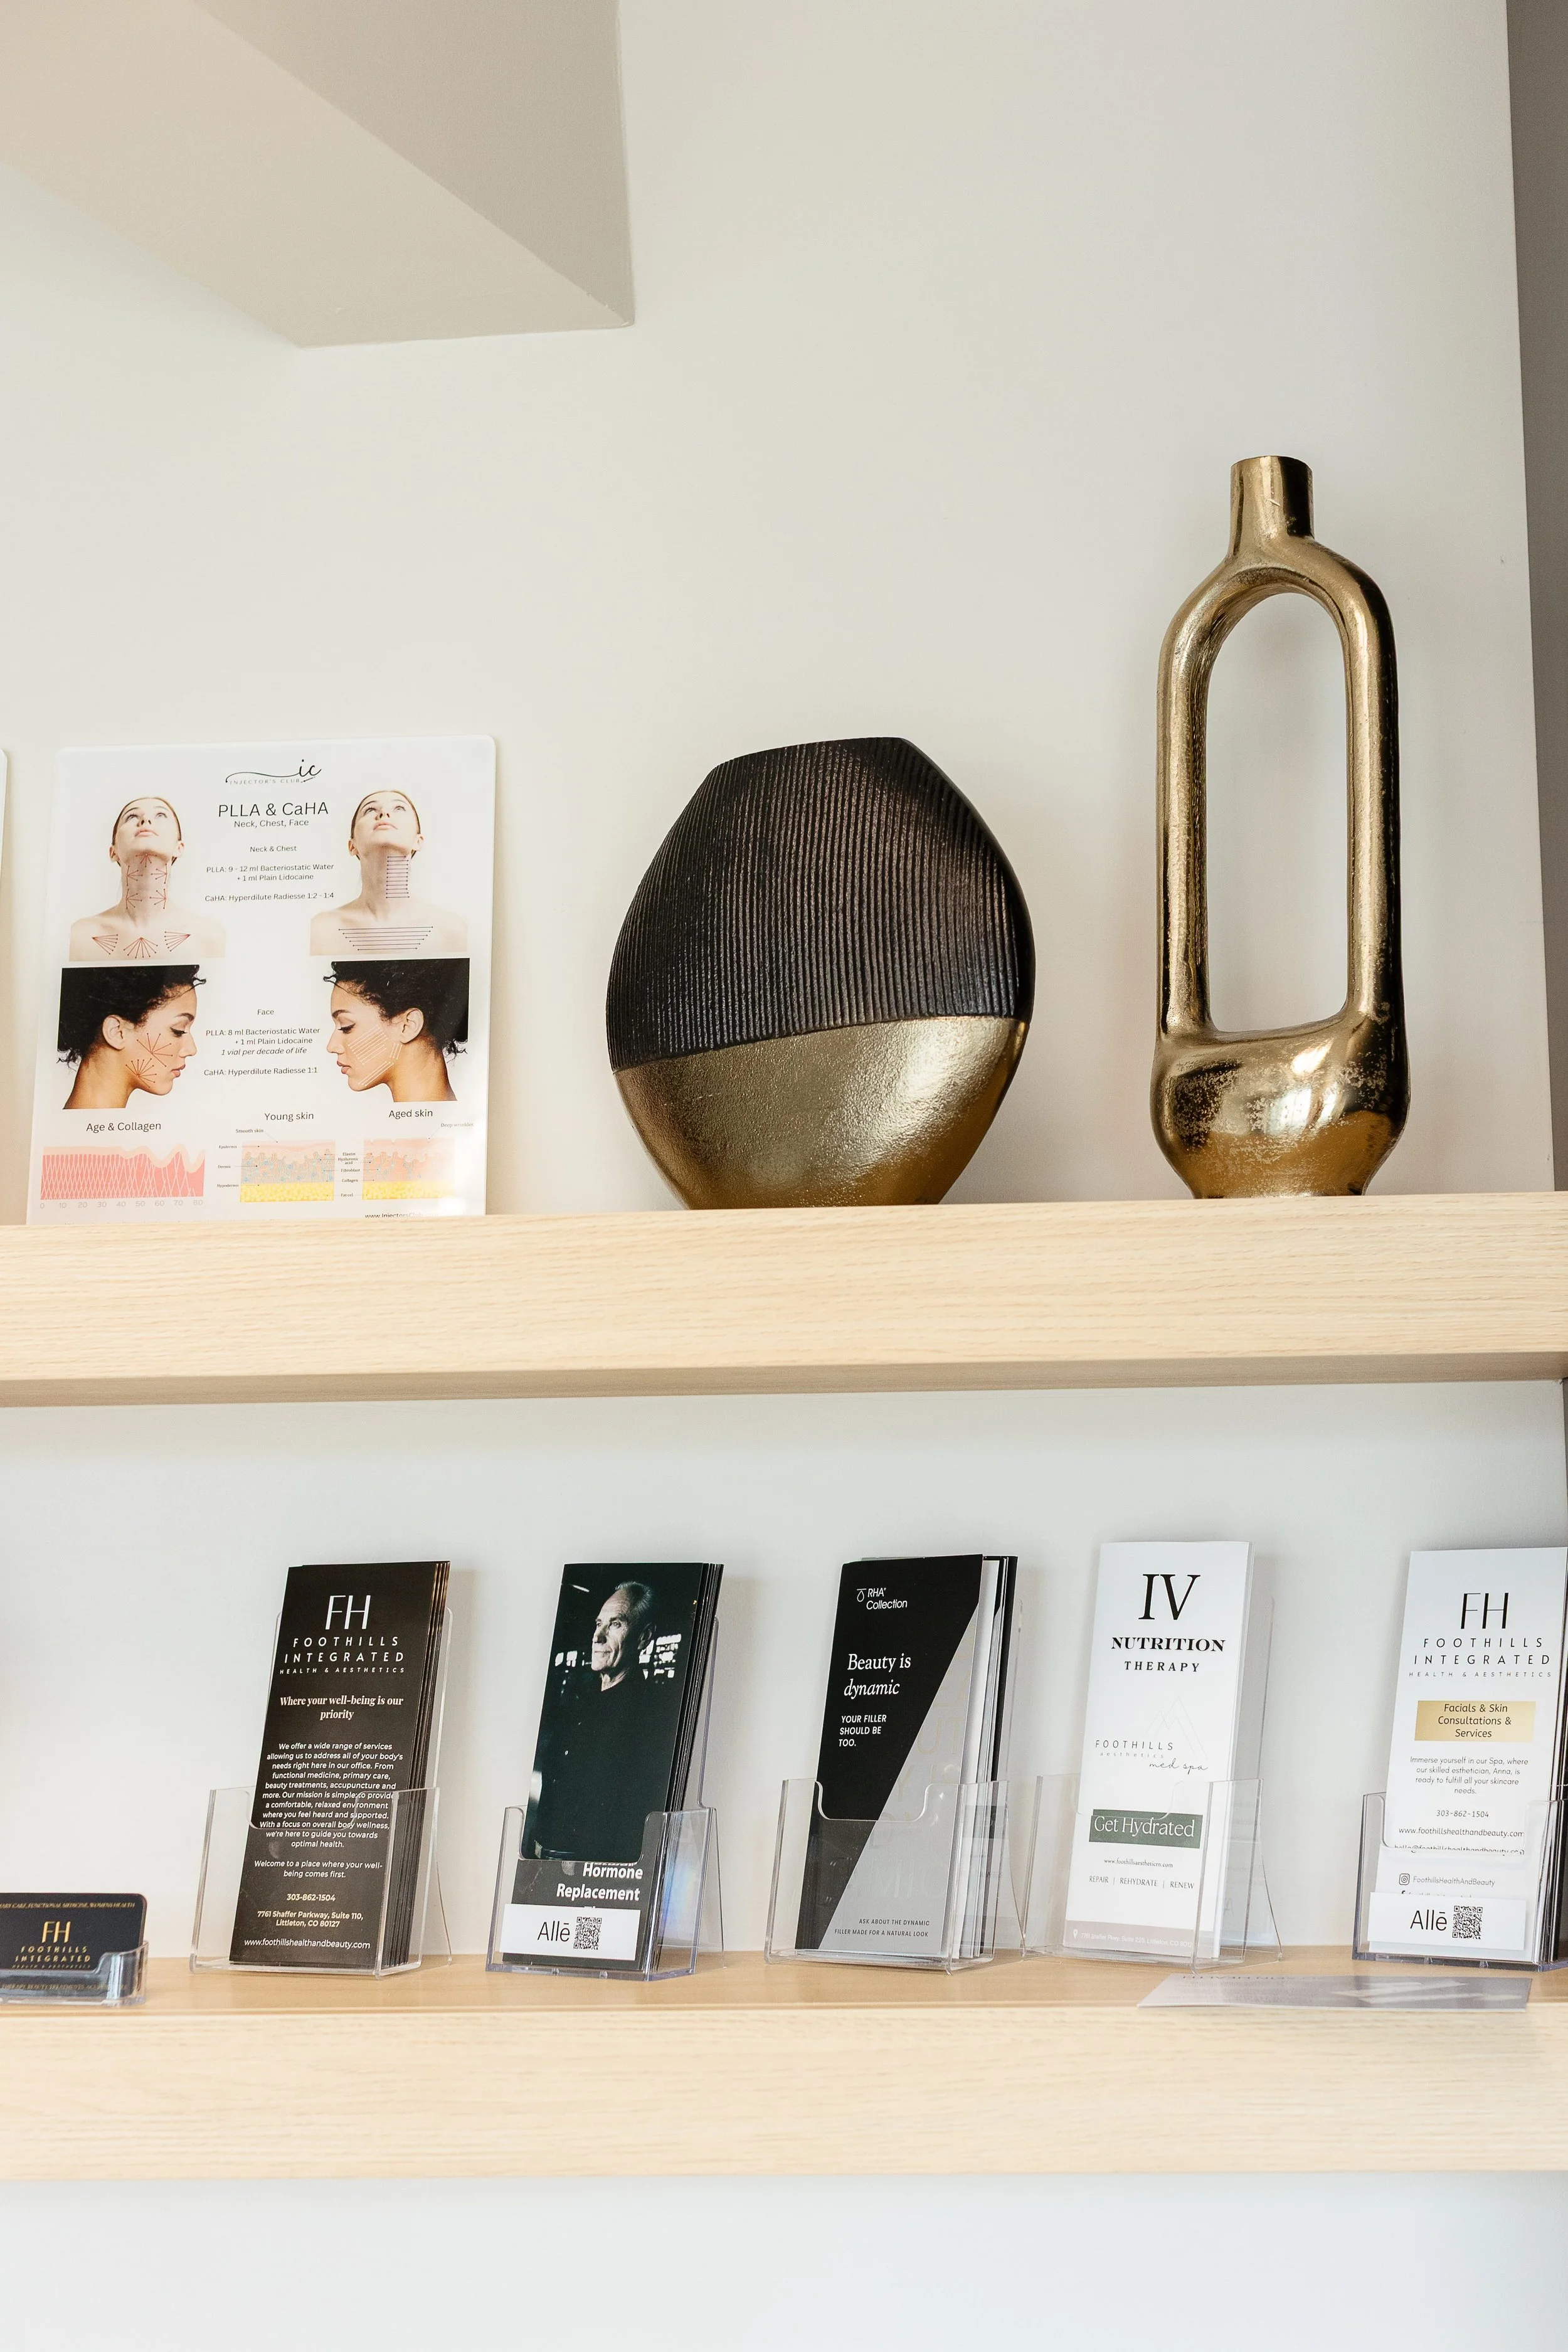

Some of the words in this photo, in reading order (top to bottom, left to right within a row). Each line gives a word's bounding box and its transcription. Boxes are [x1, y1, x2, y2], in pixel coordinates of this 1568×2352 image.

[218, 803, 260, 817] PLLA
[265, 803, 276, 815] &
[282, 802, 328, 815] CaHA
[264, 1113, 293, 1121] Young
[295, 1111, 314, 1120] skin
[388, 1109, 411, 1119] Aged
[415, 1109, 432, 1117] skin
[86, 1123, 105, 1133] Age
[107, 1122, 114, 1131] &
[1138, 1574, 1200, 1620] IV
[866, 1599, 907, 1609] Collection
[325, 1594, 371, 1629] FH
[1460, 1592, 1508, 1629] FH
[293, 1636, 398, 1647] FOOTHILLS
[1111, 1637, 1225, 1651] NUTRITION
[1423, 1638, 1542, 1648] FOOTHILLS
[284, 1651, 403, 1663] INTEGRATED
[847, 1653, 896, 1671] Beauty
[899, 1653, 911, 1668] is
[1414, 1655, 1549, 1664] INTEGRATED
[1124, 1661, 1199, 1671] THERAPY
[844, 1678, 900, 1699] dynamic
[280, 1696, 306, 1705] Where
[307, 1697, 327, 1707] your
[329, 1695, 376, 1706] well-being
[376, 1695, 385, 1705] is
[1444, 1703, 1476, 1712] Facials
[1479, 1703, 1485, 1712] &
[1489, 1703, 1507, 1712] Skin
[319, 1709, 354, 1720] priority
[841, 1715, 861, 1723] YOUR
[864, 1714, 886, 1722] FILLER
[1438, 1715, 1501, 1725] Consultations
[1505, 1716, 1511, 1725] &
[839, 1726, 870, 1735] SHOULD
[872, 1726, 881, 1734] BE
[1454, 1729, 1491, 1737] Services
[1095, 1740, 1172, 1750] FOOTHILLS
[1439, 1756, 1466, 1764] yourself
[1489, 1757, 1504, 1766] Spa,
[1451, 1766, 1490, 1774] esthetician,
[307, 1771, 341, 1779] medicine,
[342, 1771, 371, 1780] primary
[1415, 1776, 1434, 1784] ready
[1436, 1809, 1488, 1818] 303-862-1504
[1094, 1816, 1118, 1831] Get
[1121, 1816, 1194, 1836] Hydrated
[300, 1860, 320, 1868] place
[283, 1870, 303, 1878] being
[582, 1861, 643, 1879] Hormone
[1120, 1877, 1157, 1886] REHYDRATE
[556, 1883, 640, 1901] Replacement
[297, 1910, 329, 1919] Parkway,
[275, 1919, 306, 1927] Littleton,
[319, 1919, 340, 1927] 80127
[1410, 1909, 1447, 1931] Allē
[41, 1921, 70, 1942] FH
[537, 1920, 569, 1941] Allē
[244, 1937, 370, 1949] www.foothillshealthandbeauty.com
